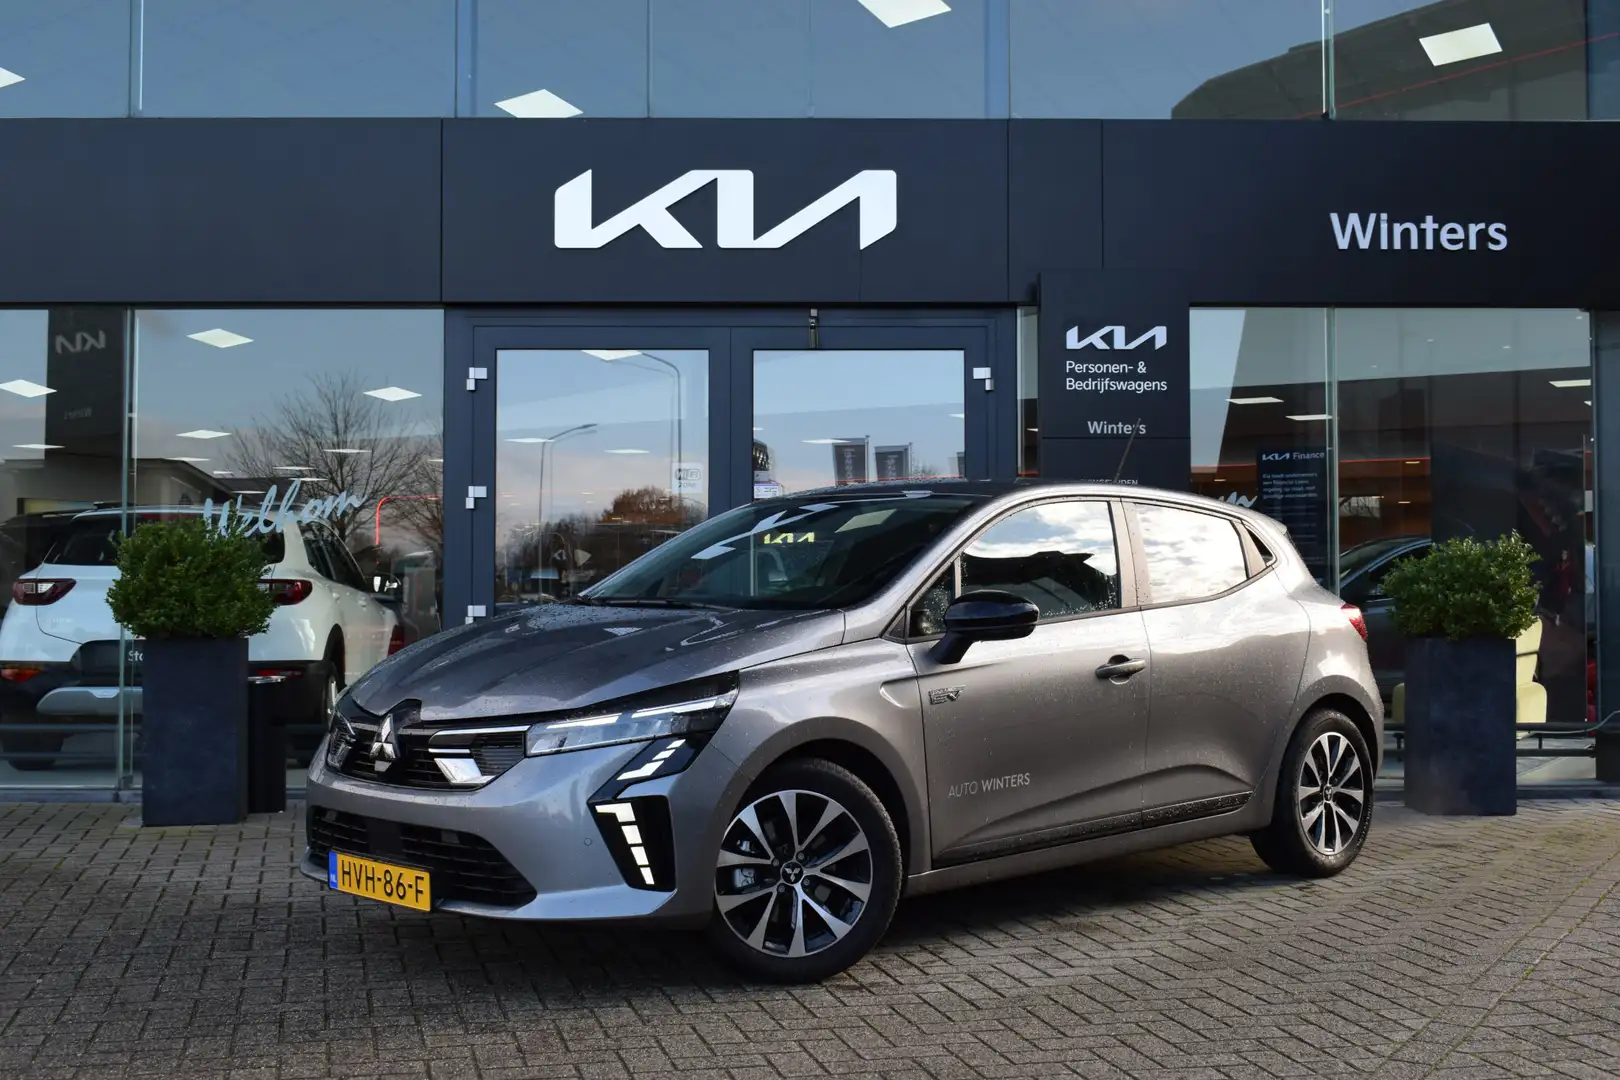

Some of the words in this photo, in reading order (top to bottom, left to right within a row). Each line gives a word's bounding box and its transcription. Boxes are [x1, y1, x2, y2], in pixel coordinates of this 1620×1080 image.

[554, 168, 897, 250] KIA
[1329, 212, 1508, 251] Winters
[1066, 325, 1167, 350] KIA
[1066, 361, 1133, 373] Personen-
[1137, 361, 1147, 373] &
[1066, 378, 1168, 393] Bedrijfswagens
[1293, 452, 1325, 460] Finance
[949, 781, 978, 797] AUTO
[982, 773, 1030, 792] WINTERS
[341, 859, 424, 903] HVH-86-F
